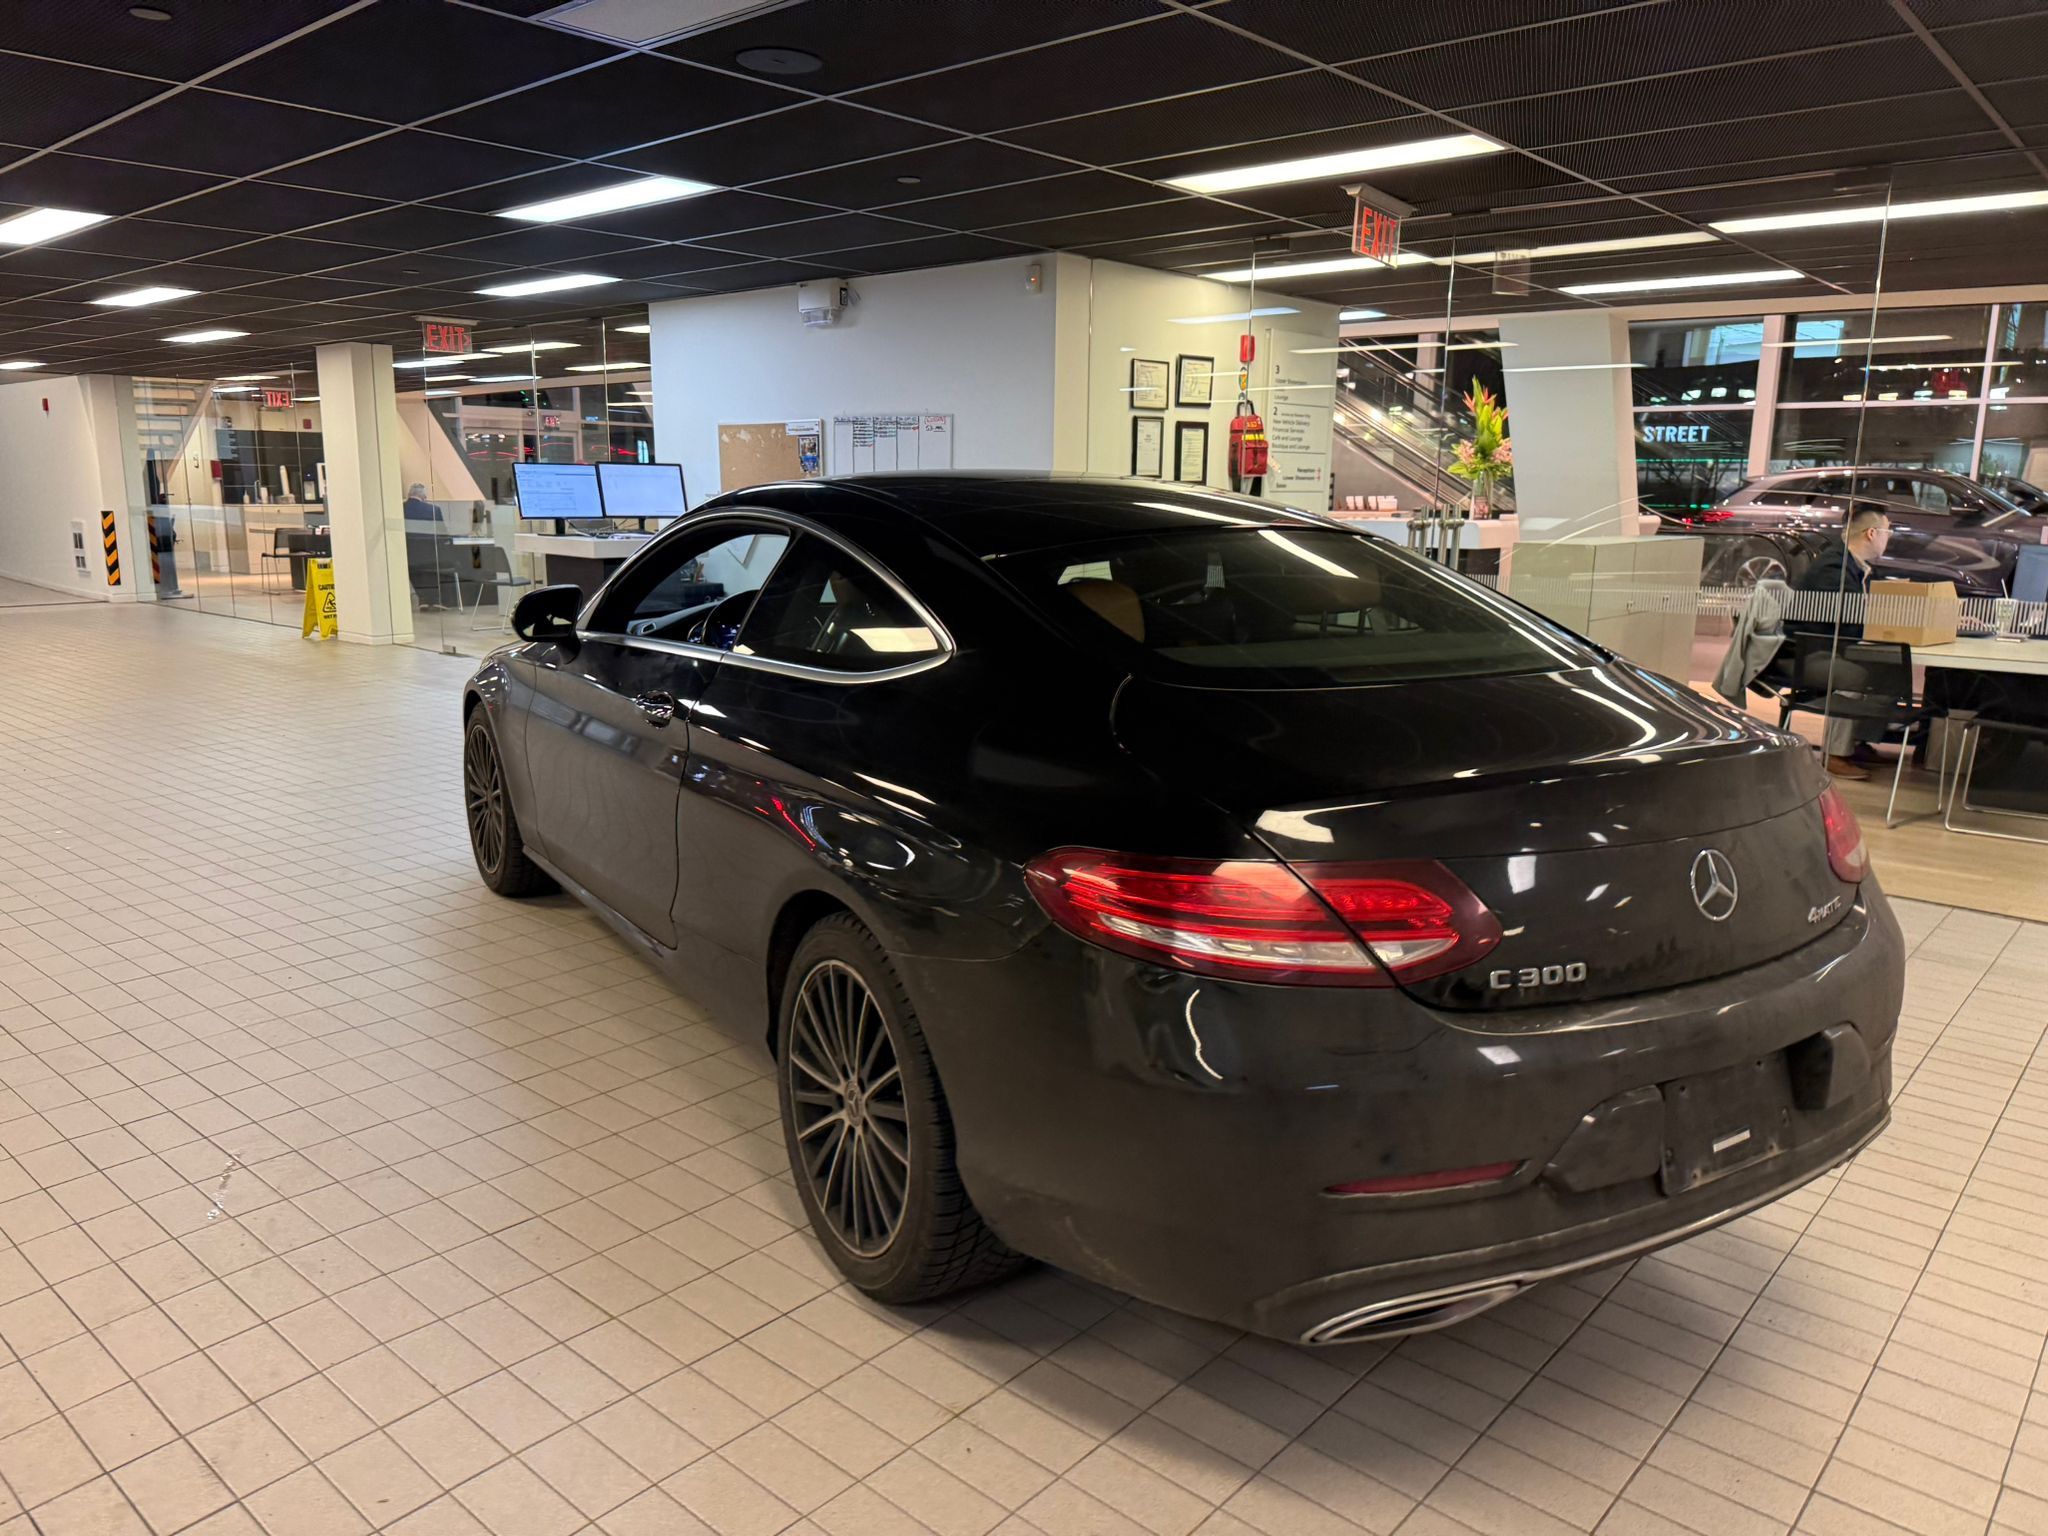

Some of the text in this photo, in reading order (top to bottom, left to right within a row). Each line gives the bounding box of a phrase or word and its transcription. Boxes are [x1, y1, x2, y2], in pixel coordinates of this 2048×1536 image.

[1361, 206, 1397, 262] EXIT
[427, 324, 465, 352] EXIT
[1275, 364, 1281, 375] 3
[1273, 406, 1278, 416] 2
[1642, 425, 1711, 443] STREET
[319, 584, 335, 592] CAUTI
[1490, 962, 1587, 989] C 300
